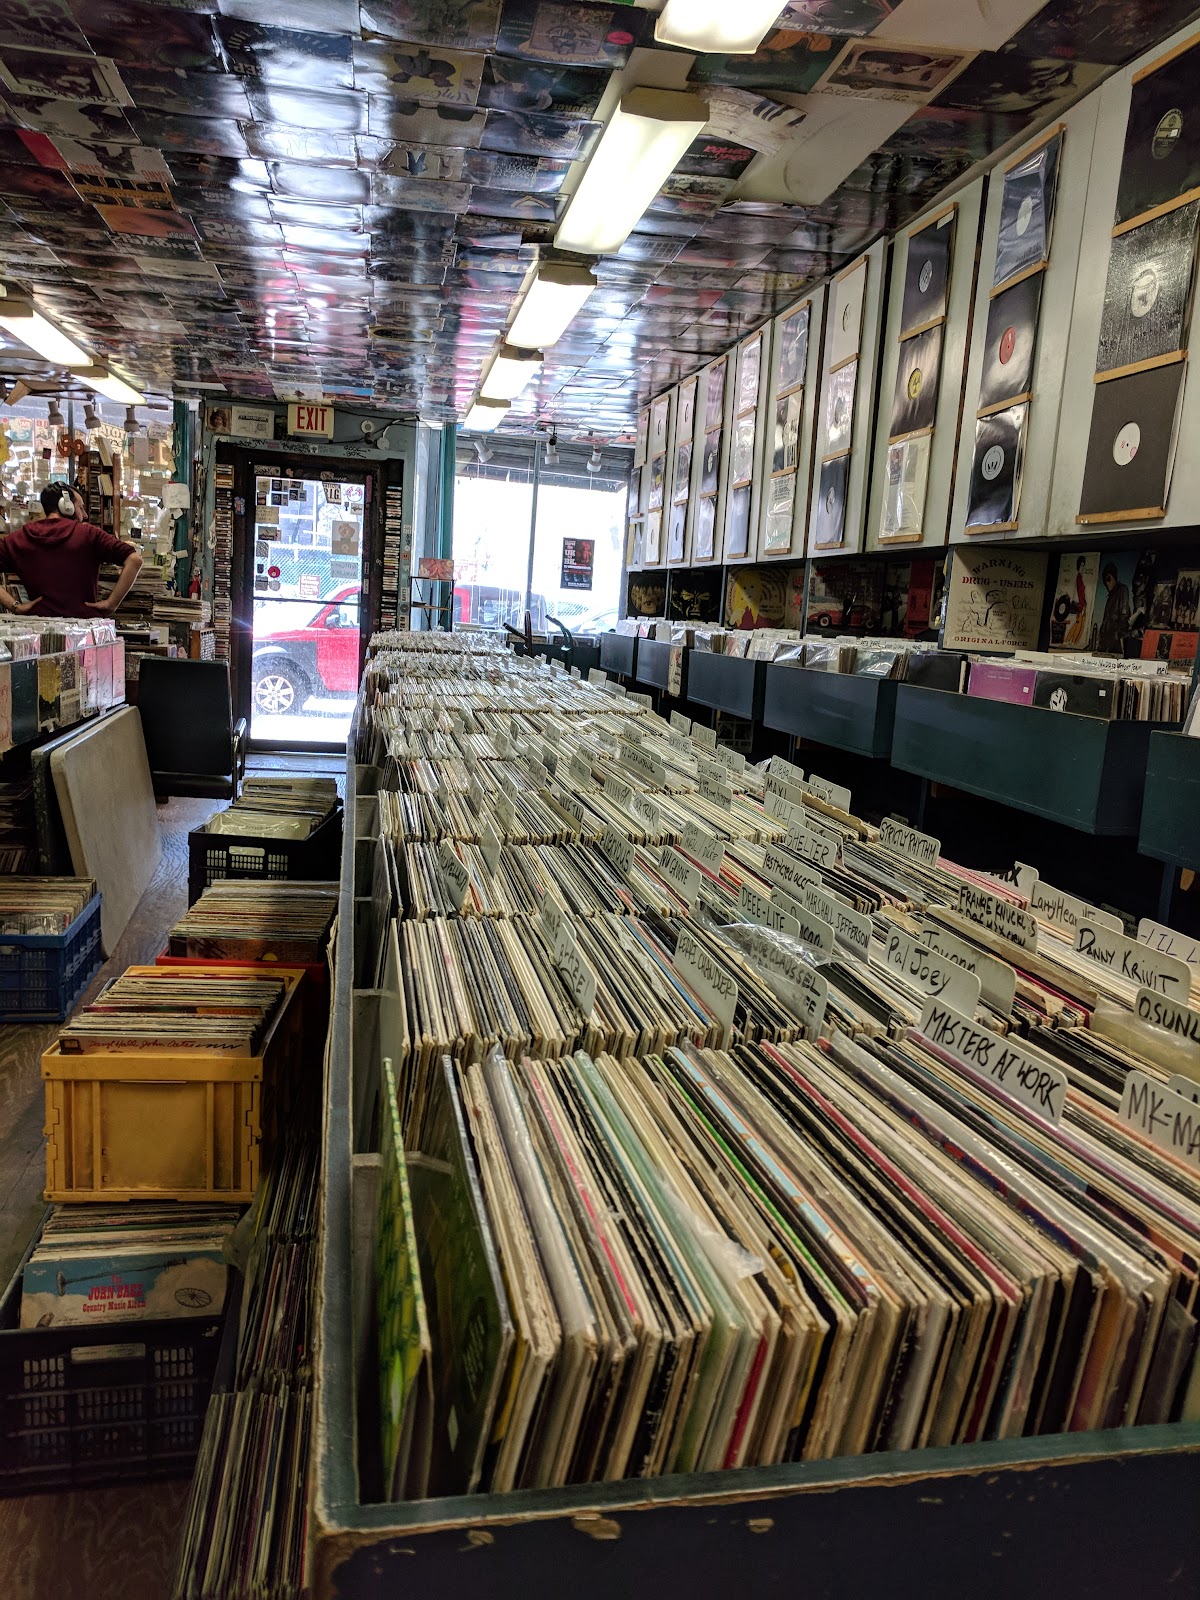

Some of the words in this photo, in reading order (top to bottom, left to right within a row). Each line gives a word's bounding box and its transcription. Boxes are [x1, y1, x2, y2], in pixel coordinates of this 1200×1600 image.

[140, 170, 169, 181] GANG
[297, 406, 328, 432] EXIT
[961, 576, 990, 586] DRUG
[999, 579, 1035, 589] USERS
[972, 558, 1026, 578] WARNING
[786, 826, 830, 866] SHELTER
[879, 821, 909, 852] STRICTLY
[908, 833, 938, 865] RHYTHM
[741, 886, 786, 932] DEEE-LITE
[805, 890, 834, 926] MARSHALL
[835, 912, 870, 949] JEFFERSON
[994, 900, 1038, 938] KNUCKLS
[768, 947, 821, 997] CLAUSSEL
[886, 935, 909, 972] Pal
[909, 948, 951, 996] Joey
[922, 1006, 997, 1067] MASTERS
[991, 1048, 1020, 1081] AT
[1016, 1060, 1061, 1118] WORK
[82, 1302, 106, 1313] Country
[107, 1300, 126, 1311] Music
[88, 1285, 114, 1301] JOAN
[117, 1283, 143, 1299] BAEZ
